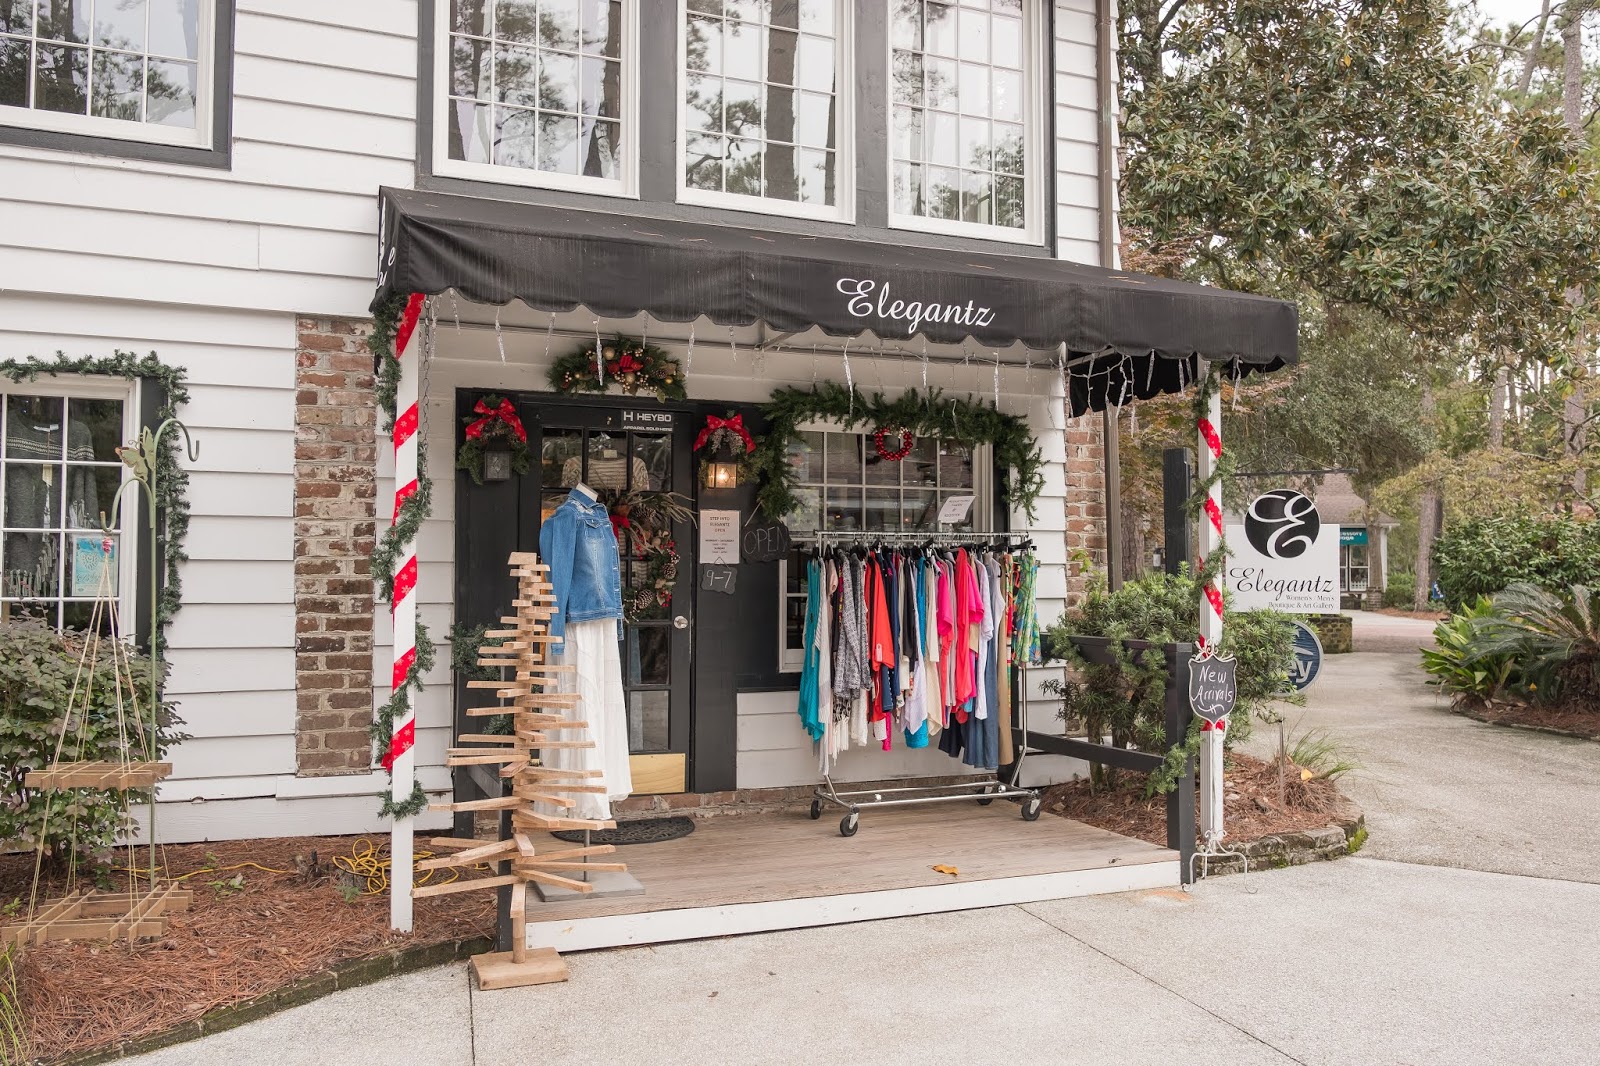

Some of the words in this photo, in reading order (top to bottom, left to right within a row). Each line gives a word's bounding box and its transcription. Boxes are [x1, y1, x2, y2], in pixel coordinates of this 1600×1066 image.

[836, 278, 996, 334] Elegantz
[624, 411, 633, 421] H
[637, 413, 671, 422] HEYBO
[743, 526, 788, 555] OPEN
[706, 569, 732, 589] 9-7
[1229, 567, 1334, 601] Elegantz
[1312, 602, 1334, 611] Gallery
[1198, 664, 1227, 684] New
[1191, 685, 1233, 707] Arrivals
